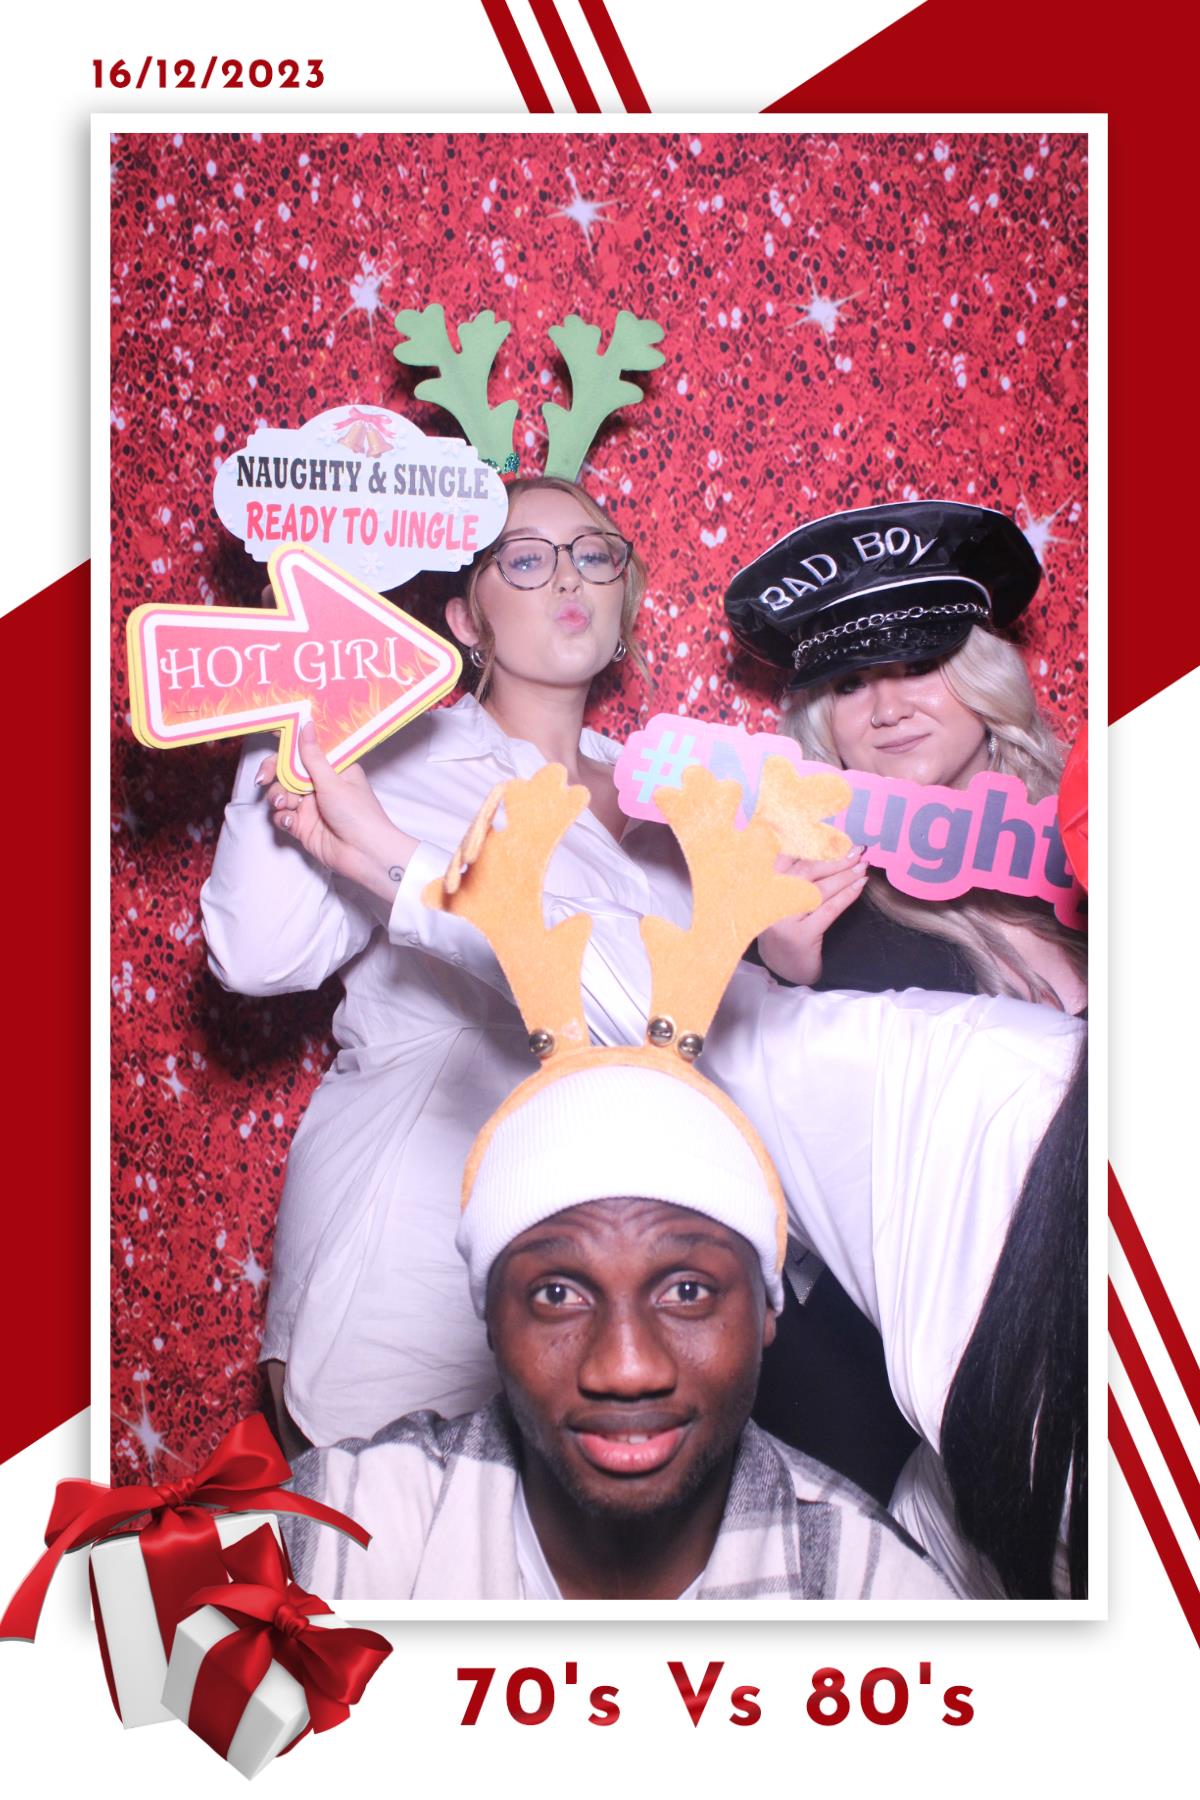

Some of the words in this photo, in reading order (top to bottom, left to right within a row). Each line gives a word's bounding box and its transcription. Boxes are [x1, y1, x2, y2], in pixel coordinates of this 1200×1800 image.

[236, 456, 362, 493] NAUGHTY
[367, 462, 387, 494] &
[393, 465, 489, 500] SINGLE
[246, 501, 337, 543] READY
[343, 507, 379, 546] TO
[384, 510, 480, 551] JINGLE
[758, 553, 838, 612] BAD
[160, 642, 281, 690] HOT
[293, 636, 417, 691] GIRL
